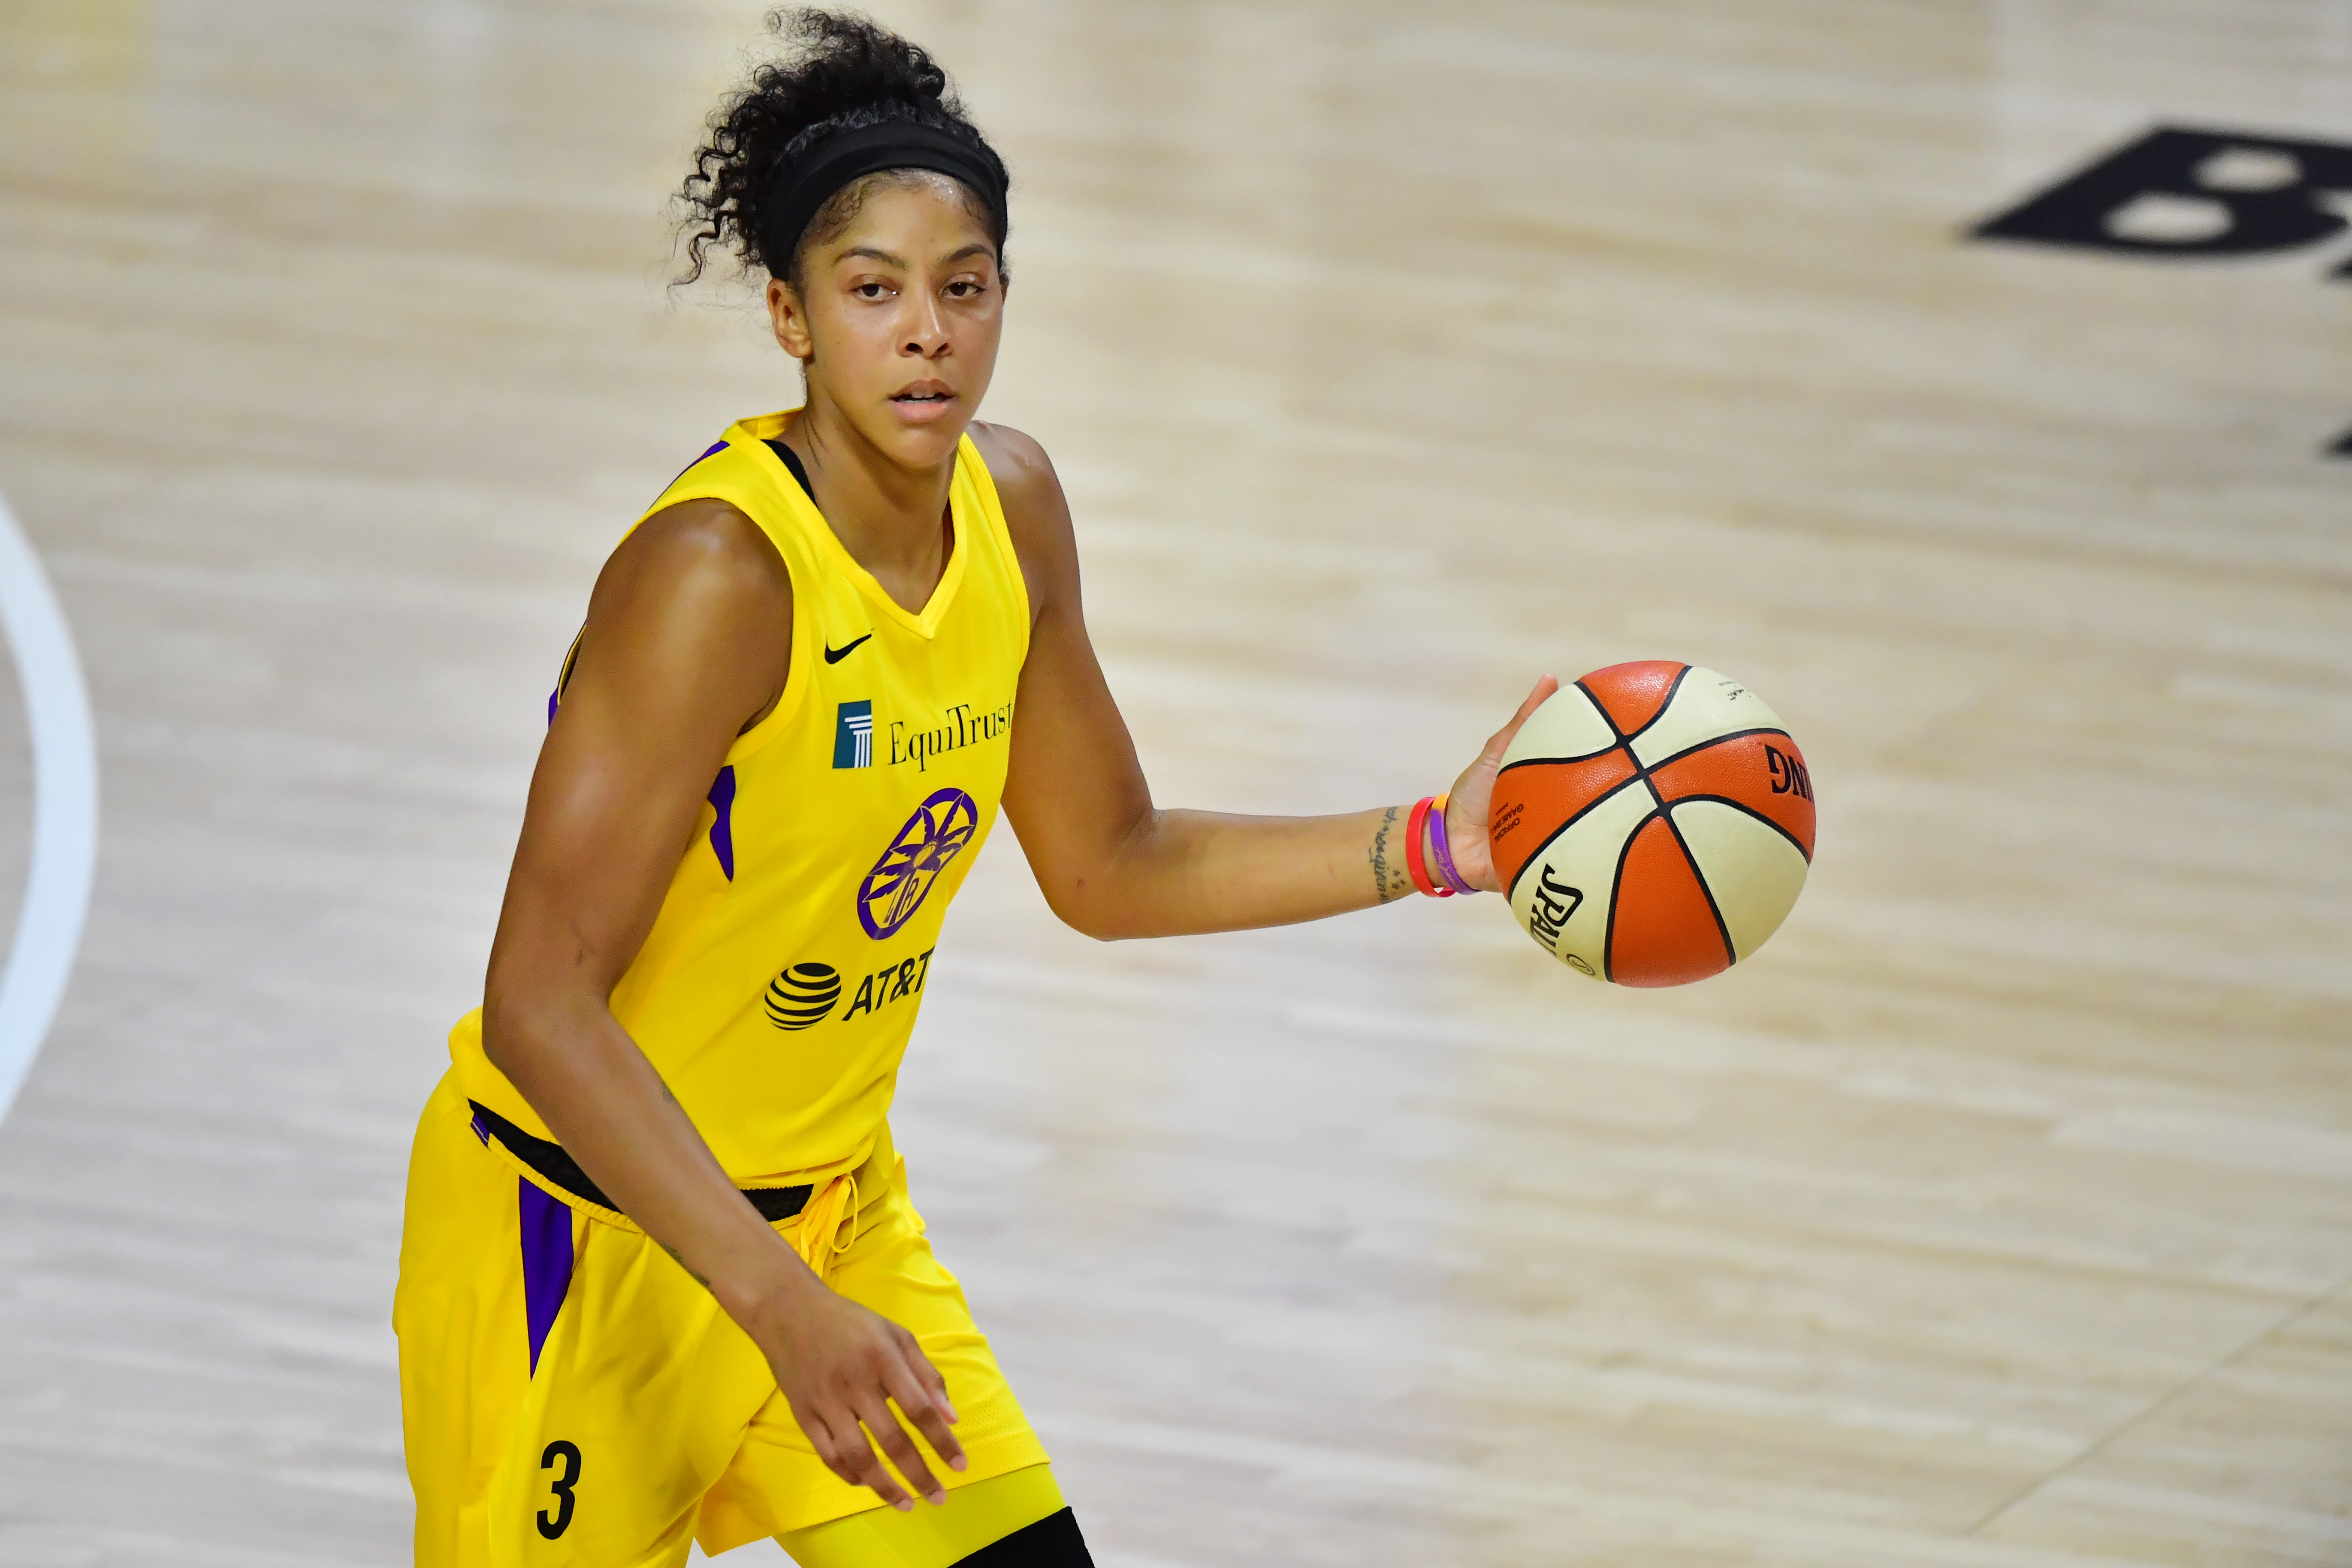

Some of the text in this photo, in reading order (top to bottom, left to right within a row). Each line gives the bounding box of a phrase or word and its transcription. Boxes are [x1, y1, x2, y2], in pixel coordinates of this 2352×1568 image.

[1969, 124, 2352, 281] B
[888, 697, 1011, 773] EquiTrust
[841, 944, 936, 1021] AT&T
[537, 1440, 582, 1540] 3
